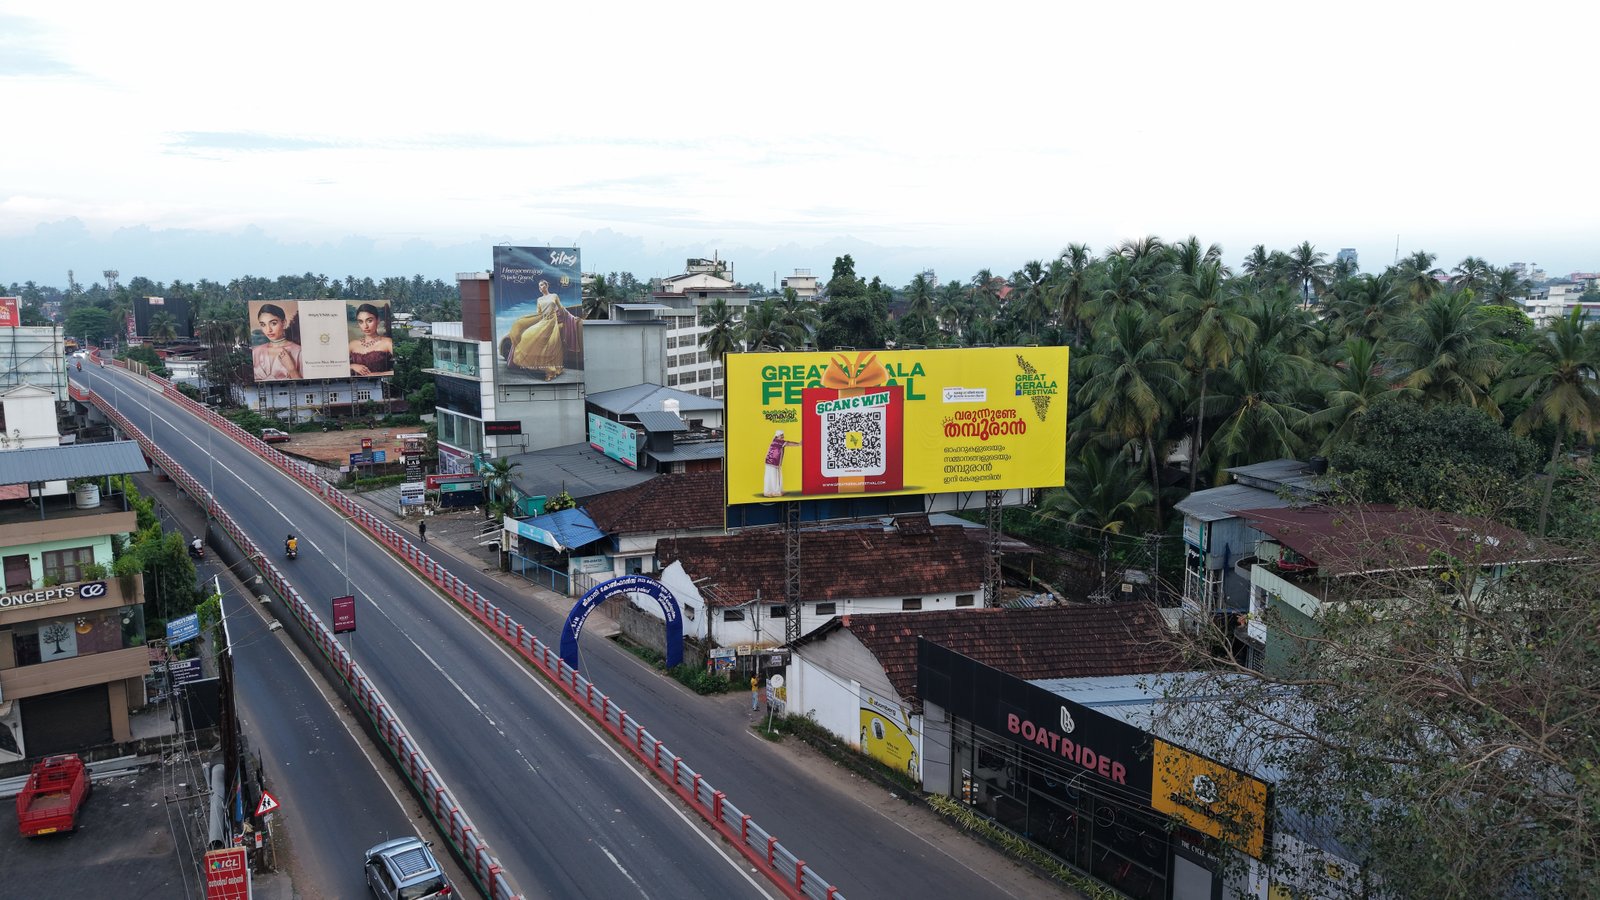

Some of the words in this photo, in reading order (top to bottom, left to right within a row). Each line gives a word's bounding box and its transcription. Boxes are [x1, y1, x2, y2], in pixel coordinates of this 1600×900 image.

[1015, 374, 1046, 382] GREAT
[1015, 381, 1058, 390] KERALA
[817, 399, 850, 414] SCAN
[861, 393, 889, 406] WIN
[1008, 713, 1126, 785] BOATRIDER
[1182, 840, 1190, 850] THE
[1191, 845, 1205, 857] CYCLE
[222, 859, 238, 868] ICL
